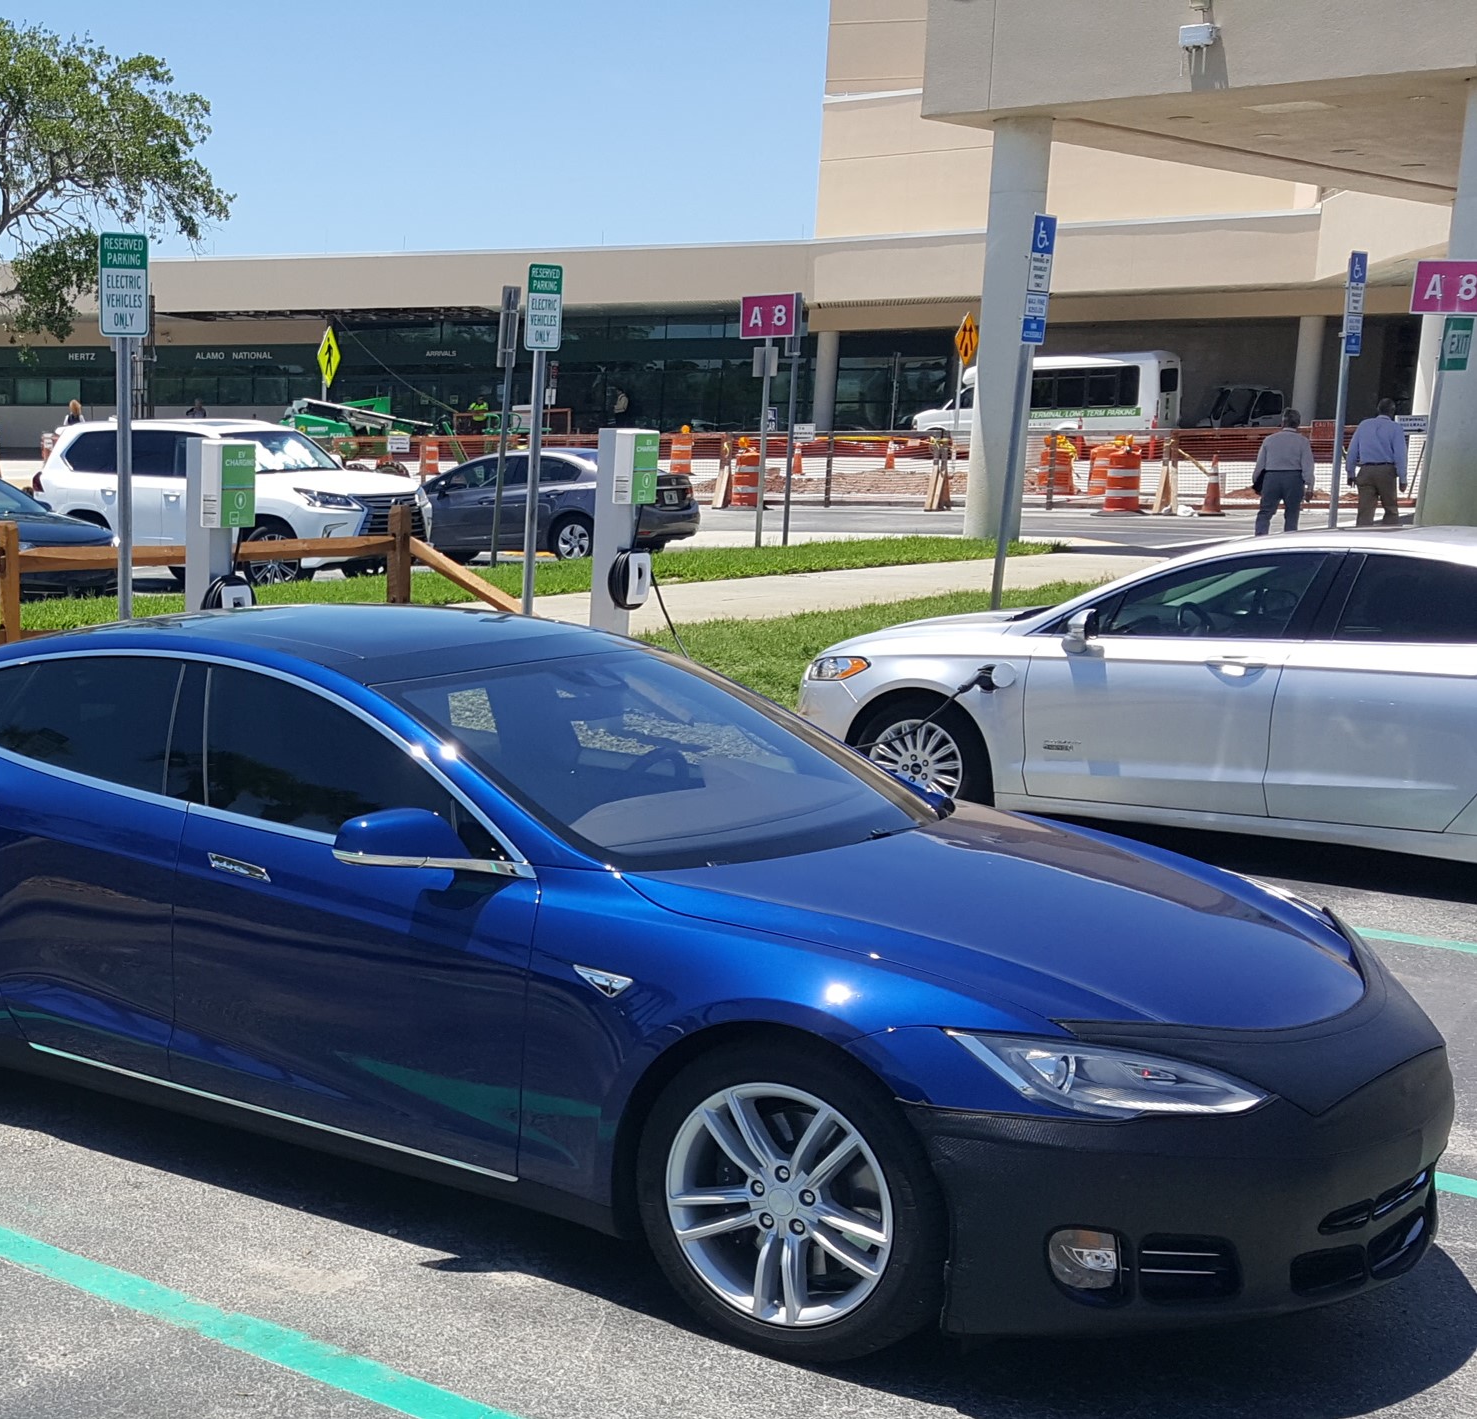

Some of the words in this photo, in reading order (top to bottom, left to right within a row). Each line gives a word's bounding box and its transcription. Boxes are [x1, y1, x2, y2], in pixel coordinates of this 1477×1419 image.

[103, 237, 144, 251] RESERVED
[106, 252, 141, 266] PARKING
[531, 267, 561, 279] RESERVED
[106, 274, 141, 289] ELECTRIC
[532, 280, 558, 291] PARKING
[1423, 273, 1442, 300] A
[1459, 273, 1477, 301] 8
[105, 293, 143, 308] VEHICLES
[531, 298, 557, 311] ELECTRIC
[113, 312, 134, 327] ONLY
[530, 314, 557, 327] VEHICLES
[749, 306, 763, 328] A
[773, 304, 787, 326] 8
[534, 330, 551, 343] ONLY
[1449, 333, 1470, 354] EXIT
[68, 352, 96, 361] HERTZ
[195, 352, 225, 360] ALAMO
[232, 352, 273, 360] NATIONAL
[1086, 408, 1106, 417] TERM
[1106, 407, 1136, 416] PARKING
